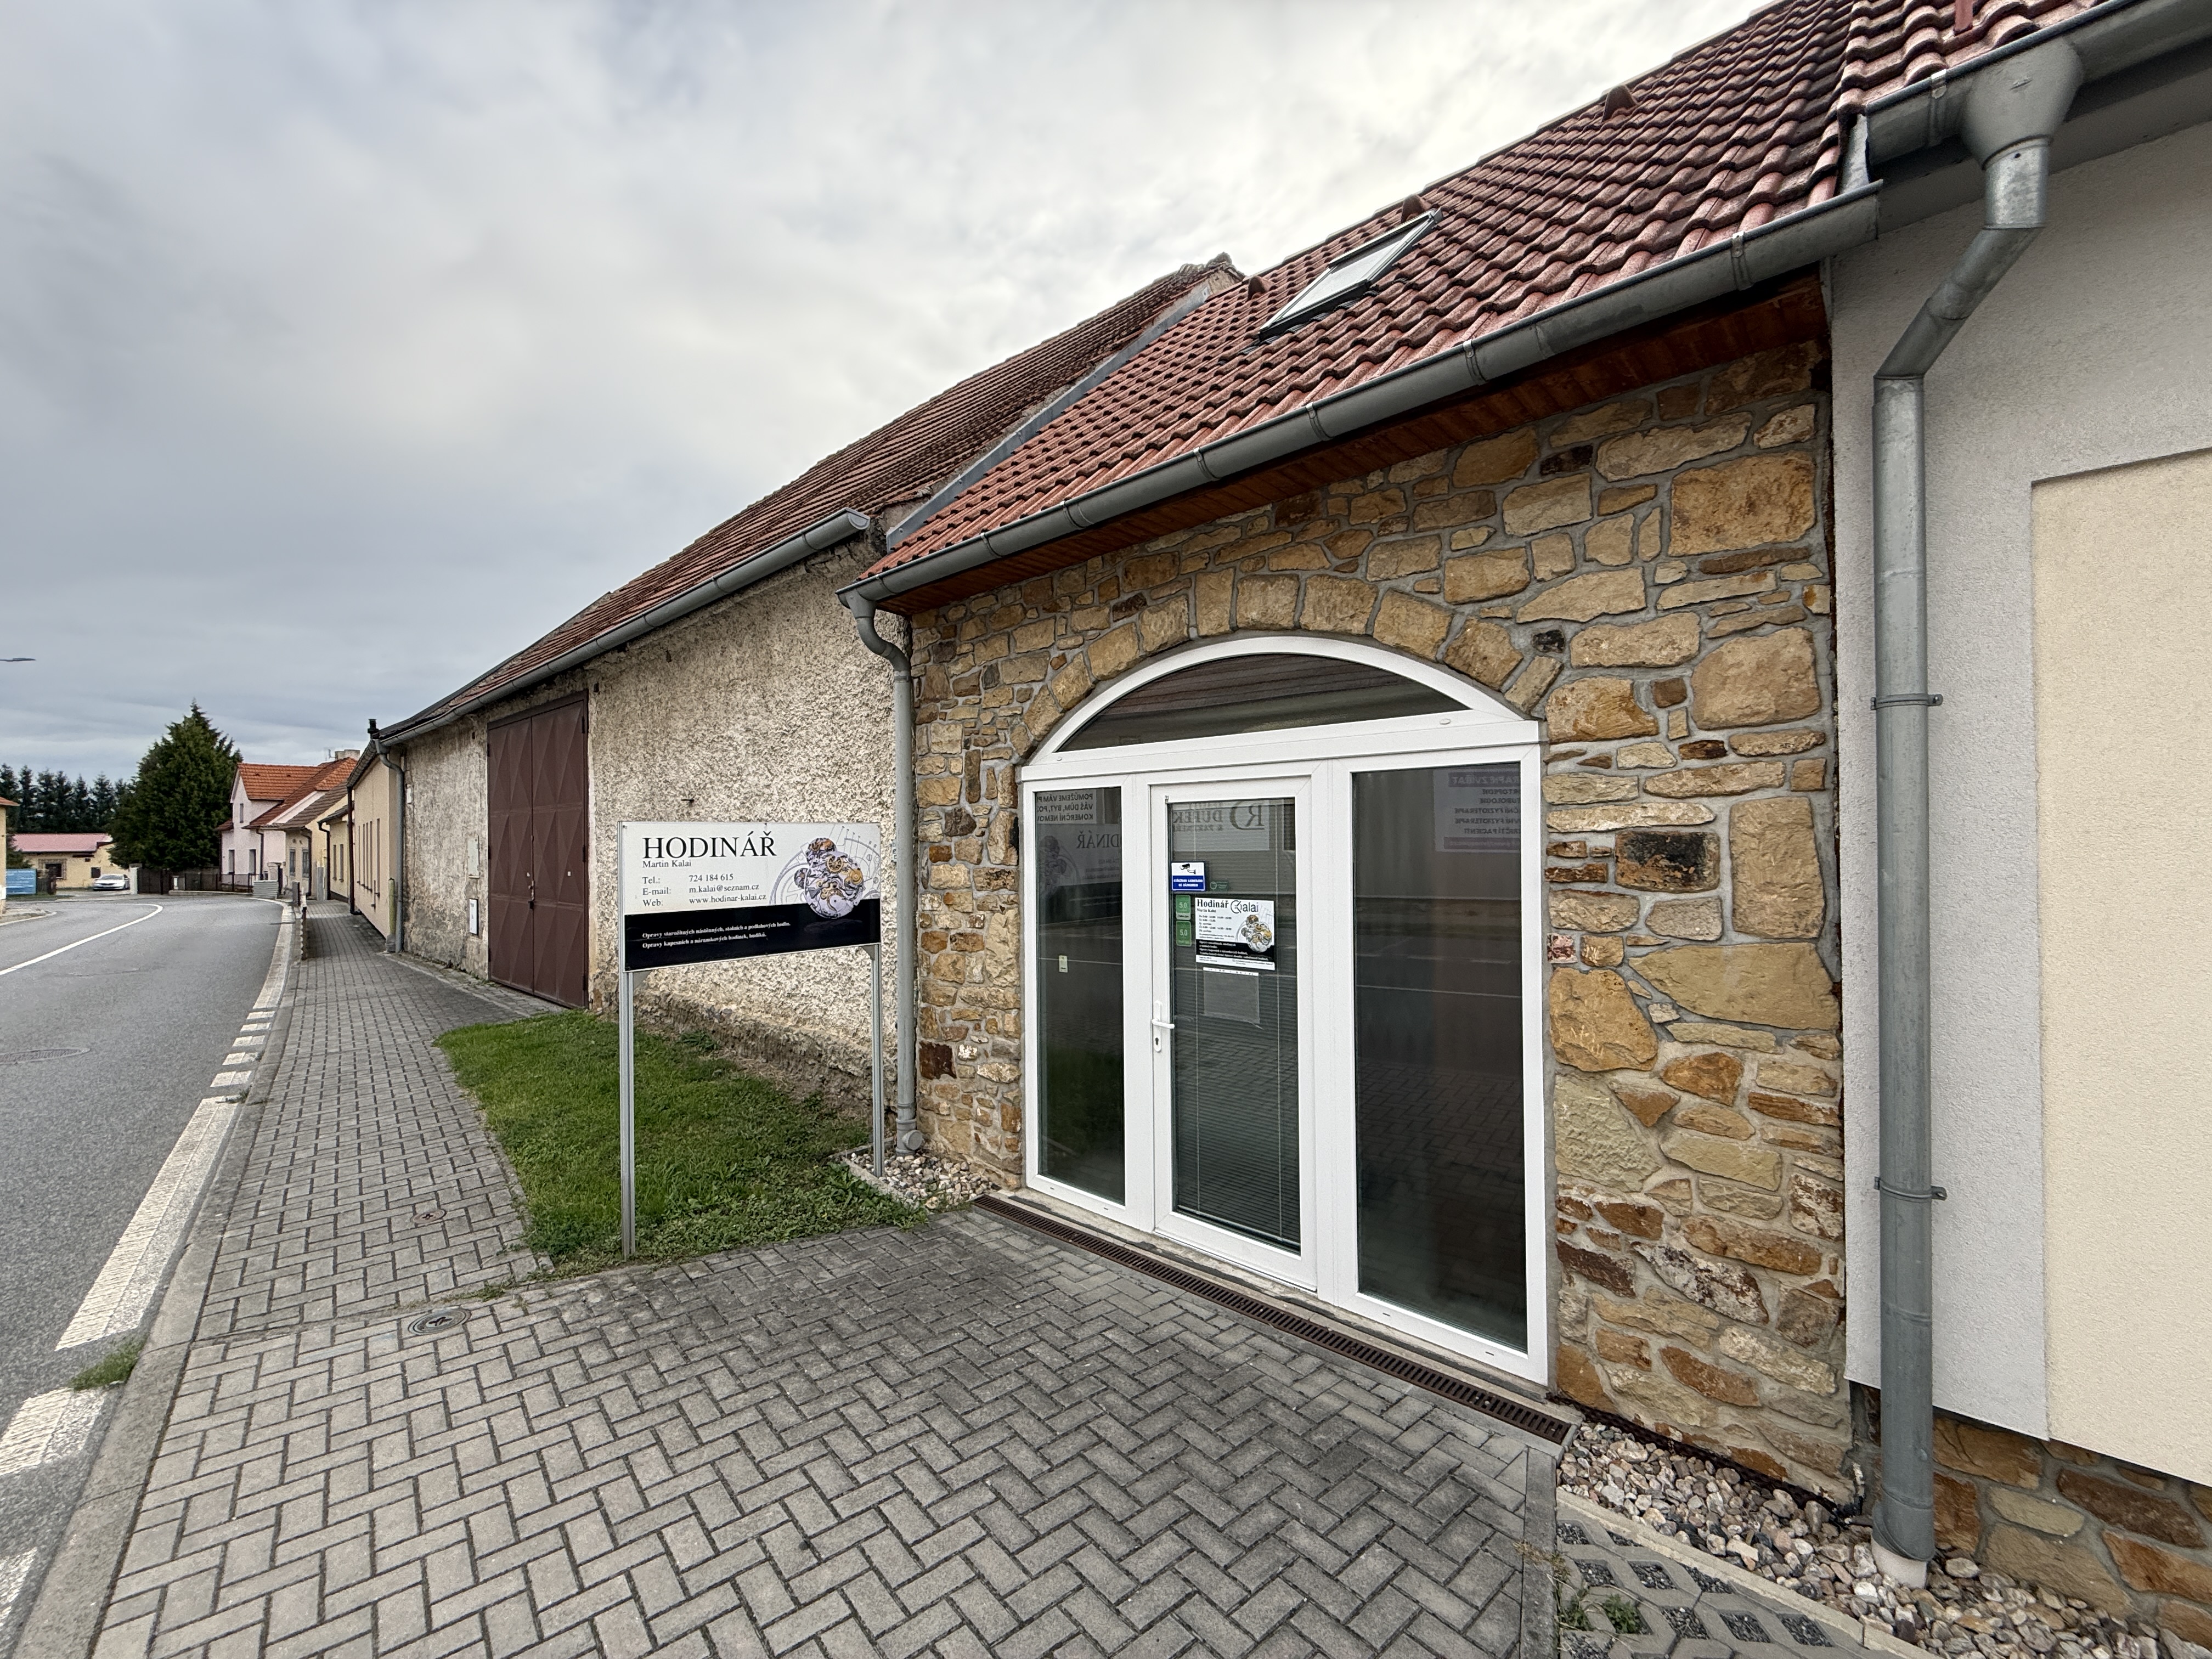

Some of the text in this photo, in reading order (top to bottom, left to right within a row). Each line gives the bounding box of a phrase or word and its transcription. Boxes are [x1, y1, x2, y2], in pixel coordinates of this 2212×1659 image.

[642, 831, 776, 859] HODINÁŘ
[642, 884, 759, 895] E-mail: m.kalai@seznam.cz
[689, 894, 766, 904] www.hodinar-kalai.cz
[1197, 899, 1229, 908] Hodinář
